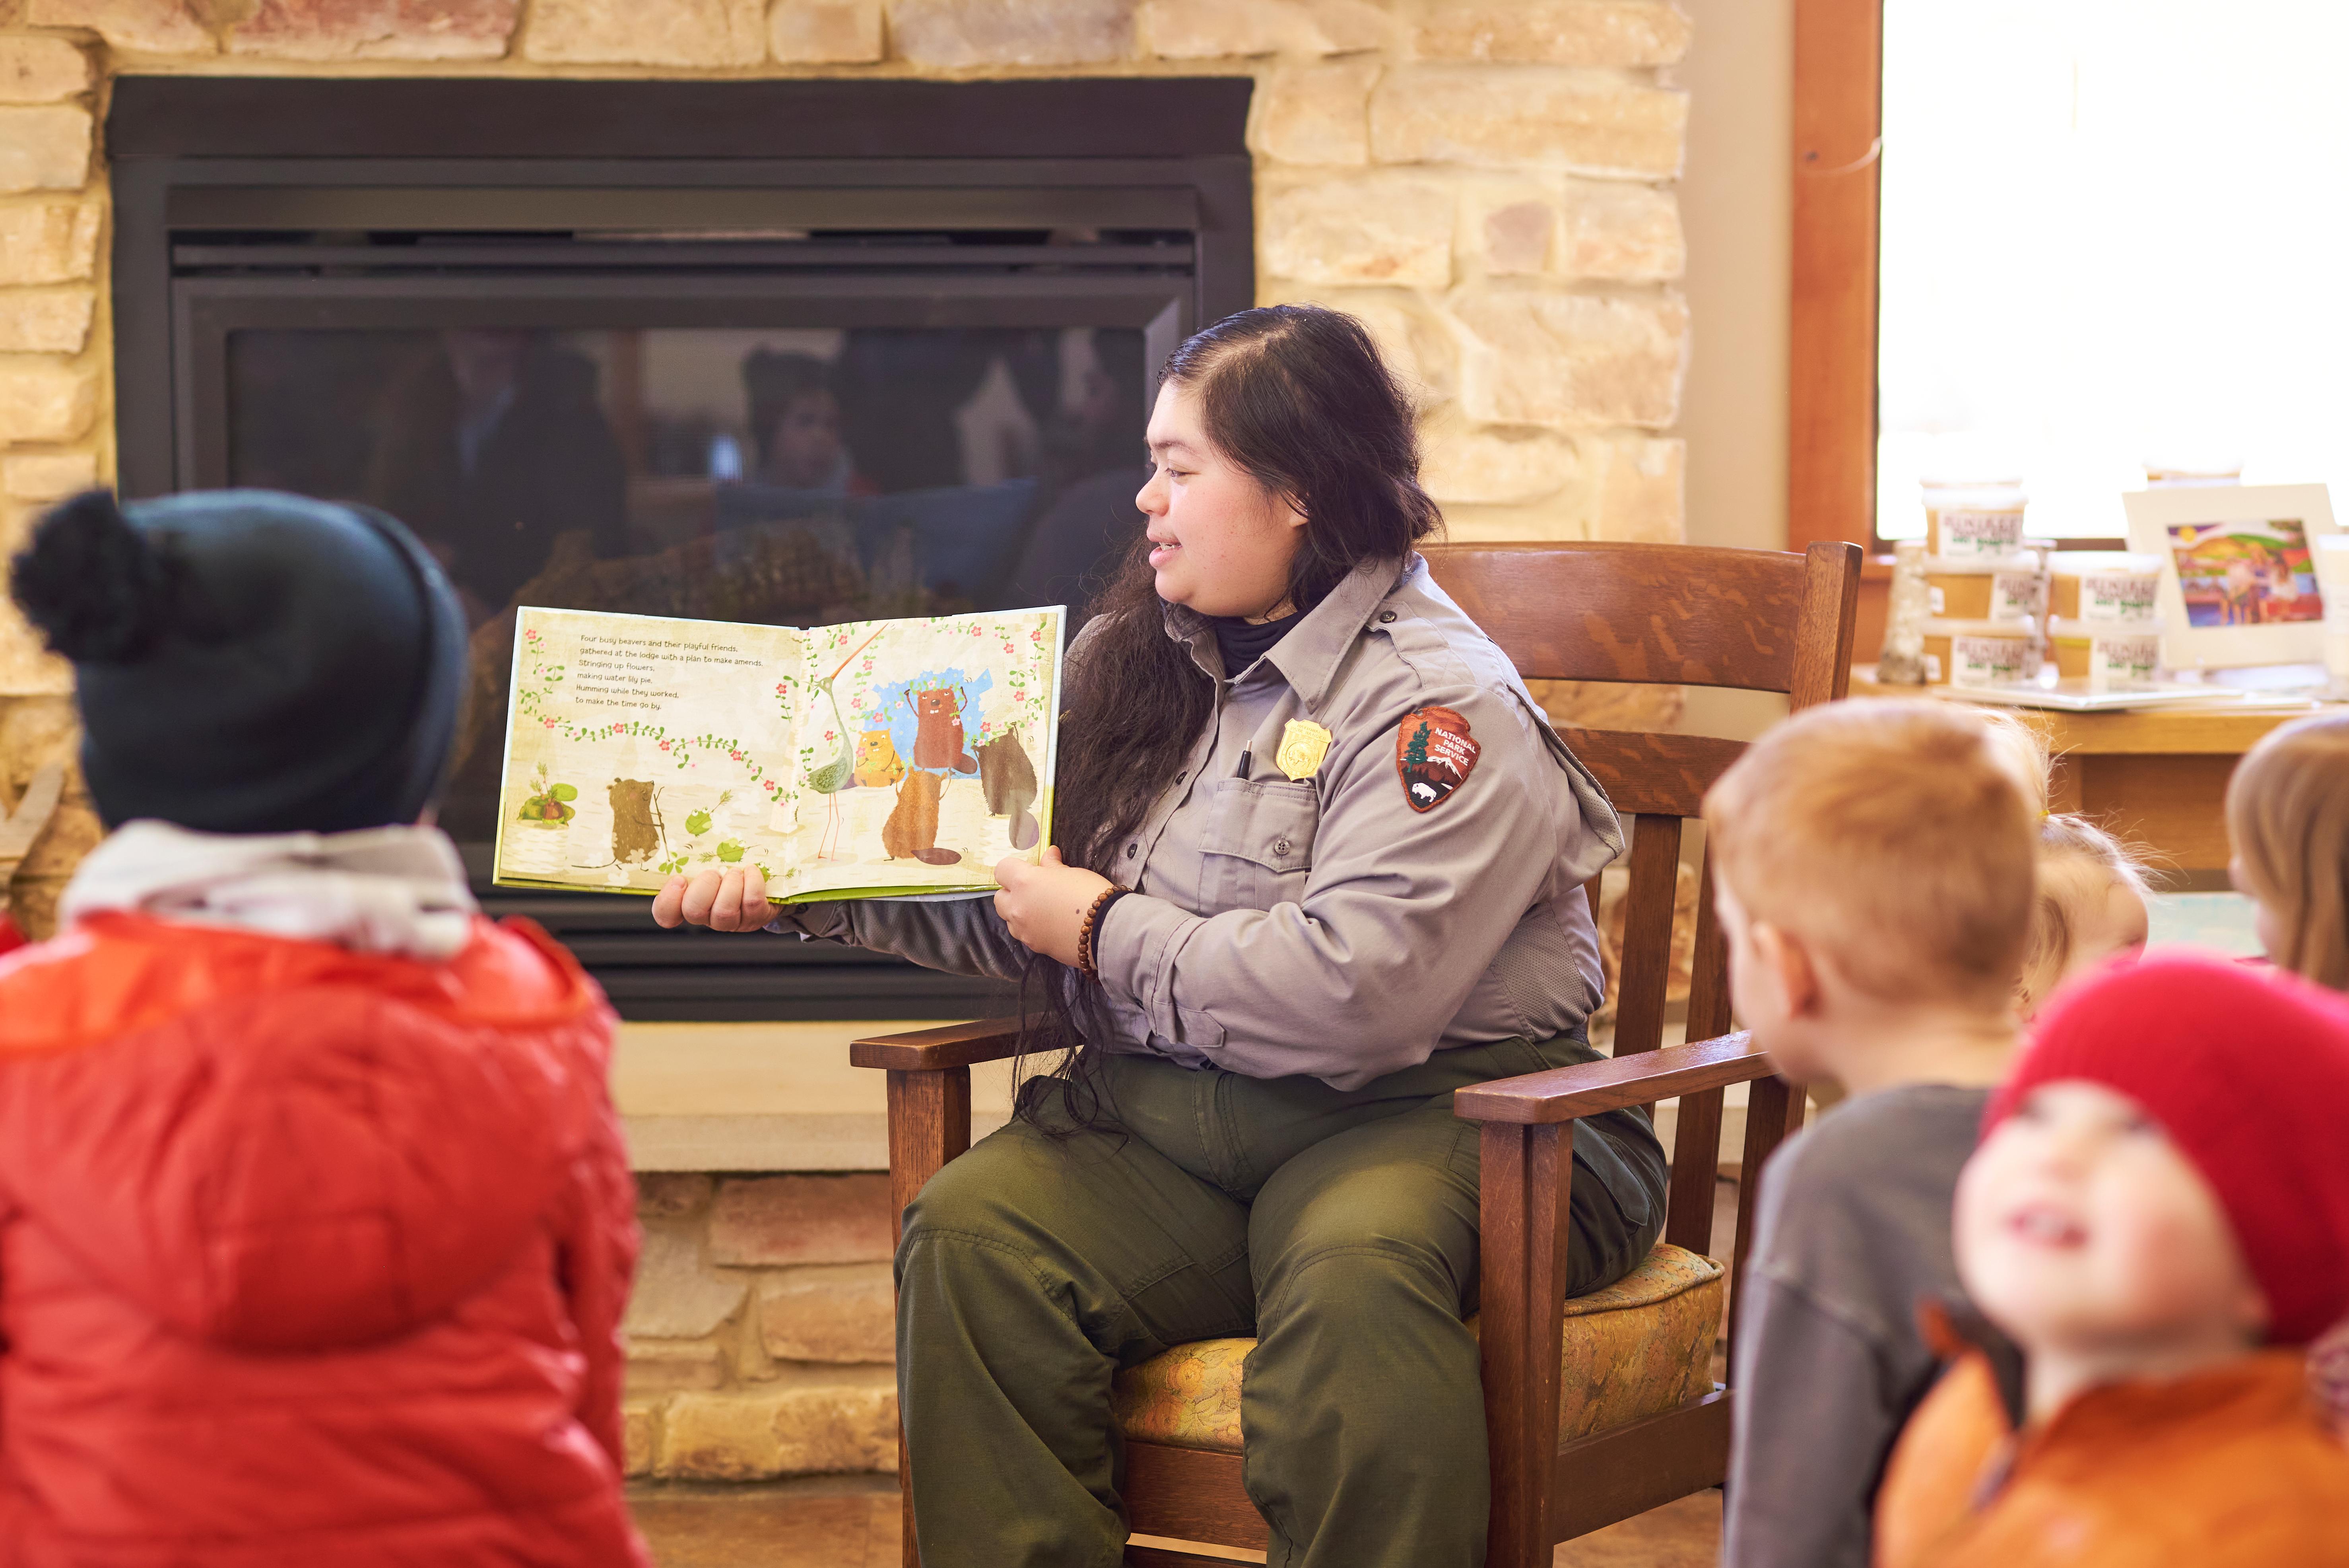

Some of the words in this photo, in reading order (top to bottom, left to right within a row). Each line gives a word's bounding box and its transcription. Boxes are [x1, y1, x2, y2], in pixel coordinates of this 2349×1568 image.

[599, 637, 616, 645] busy
[711, 643, 738, 652] friends,
[580, 648, 612, 656] gathered
[579, 659, 612, 668] Stringing
[576, 684, 609, 693] Humming
[632, 688, 648, 697] they
[651, 702, 662, 710] by.
[1297, 724, 1321, 734] NATIONAL
[1305, 731, 1326, 741] RANGER
[1435, 727, 1475, 753] NATIONAL
[1443, 739, 1466, 755] PARK
[1435, 744, 1469, 766] SERVICE
